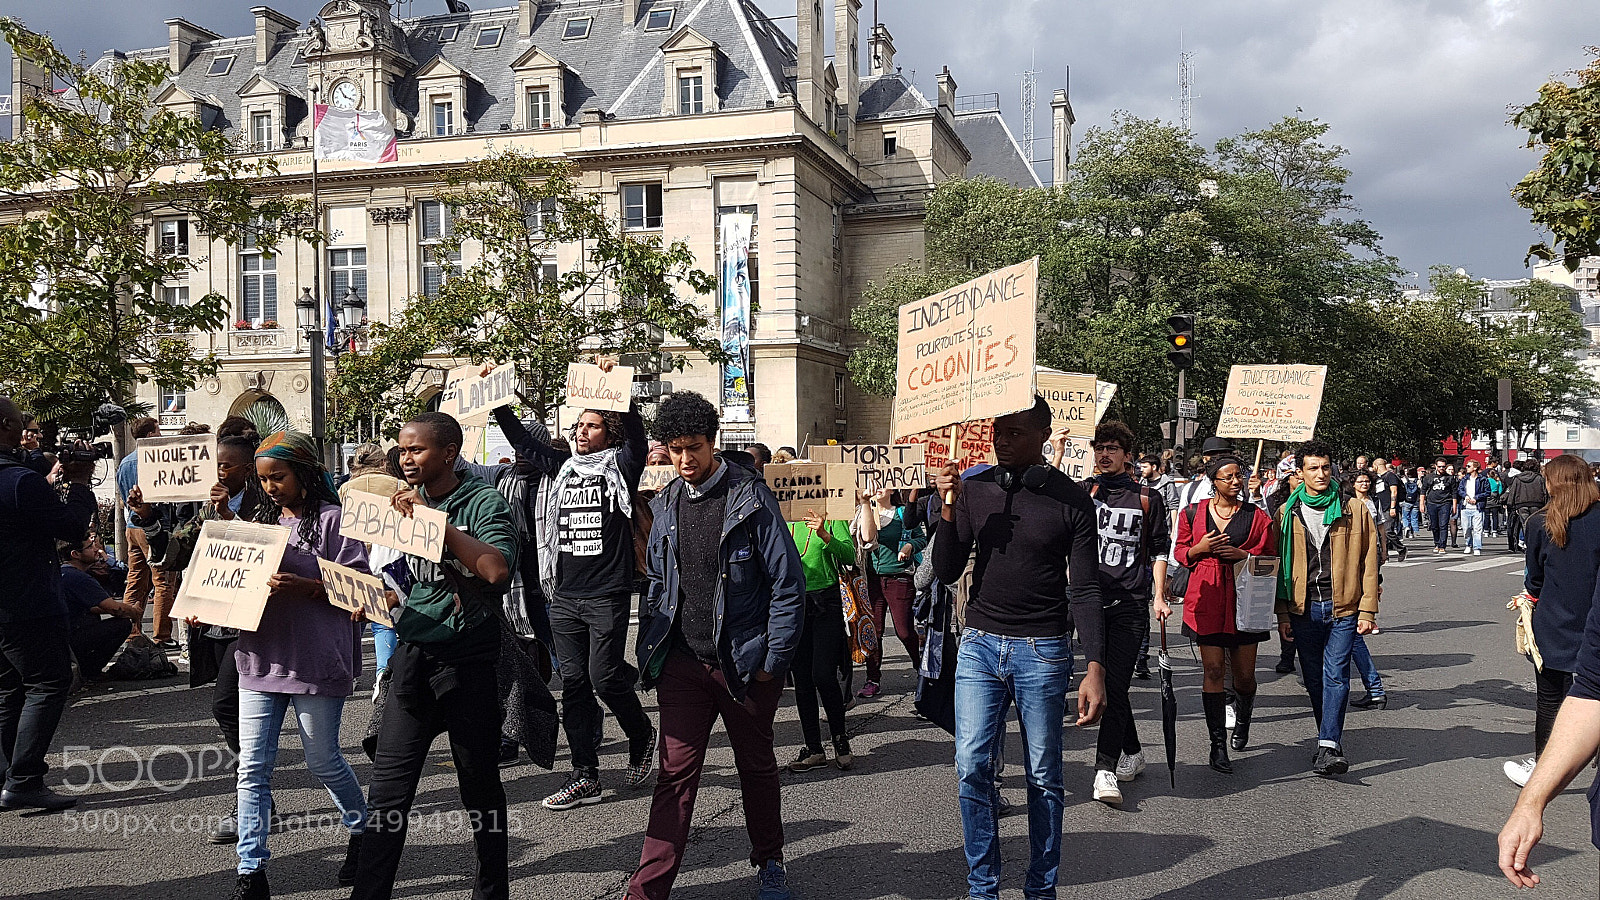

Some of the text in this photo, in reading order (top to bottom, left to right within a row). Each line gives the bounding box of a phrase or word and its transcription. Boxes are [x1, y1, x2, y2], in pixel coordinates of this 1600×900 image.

[457, 367, 514, 415] LAMINE
[567, 369, 625, 409] Abdoulaye
[1051, 406, 1086, 422] RANCE
[840, 445, 912, 465] MORT
[961, 441, 992, 453] DANS
[969, 451, 985, 460] LA
[774, 475, 822, 488] GRAND.E
[855, 462, 926, 489] TRIARCAT
[563, 488, 600, 505] DAMA
[341, 496, 440, 554] BABACAR
[570, 513, 601, 527] justice
[569, 528, 602, 539] n'aurez
[573, 543, 580, 552] la
[583, 542, 602, 554] paix
